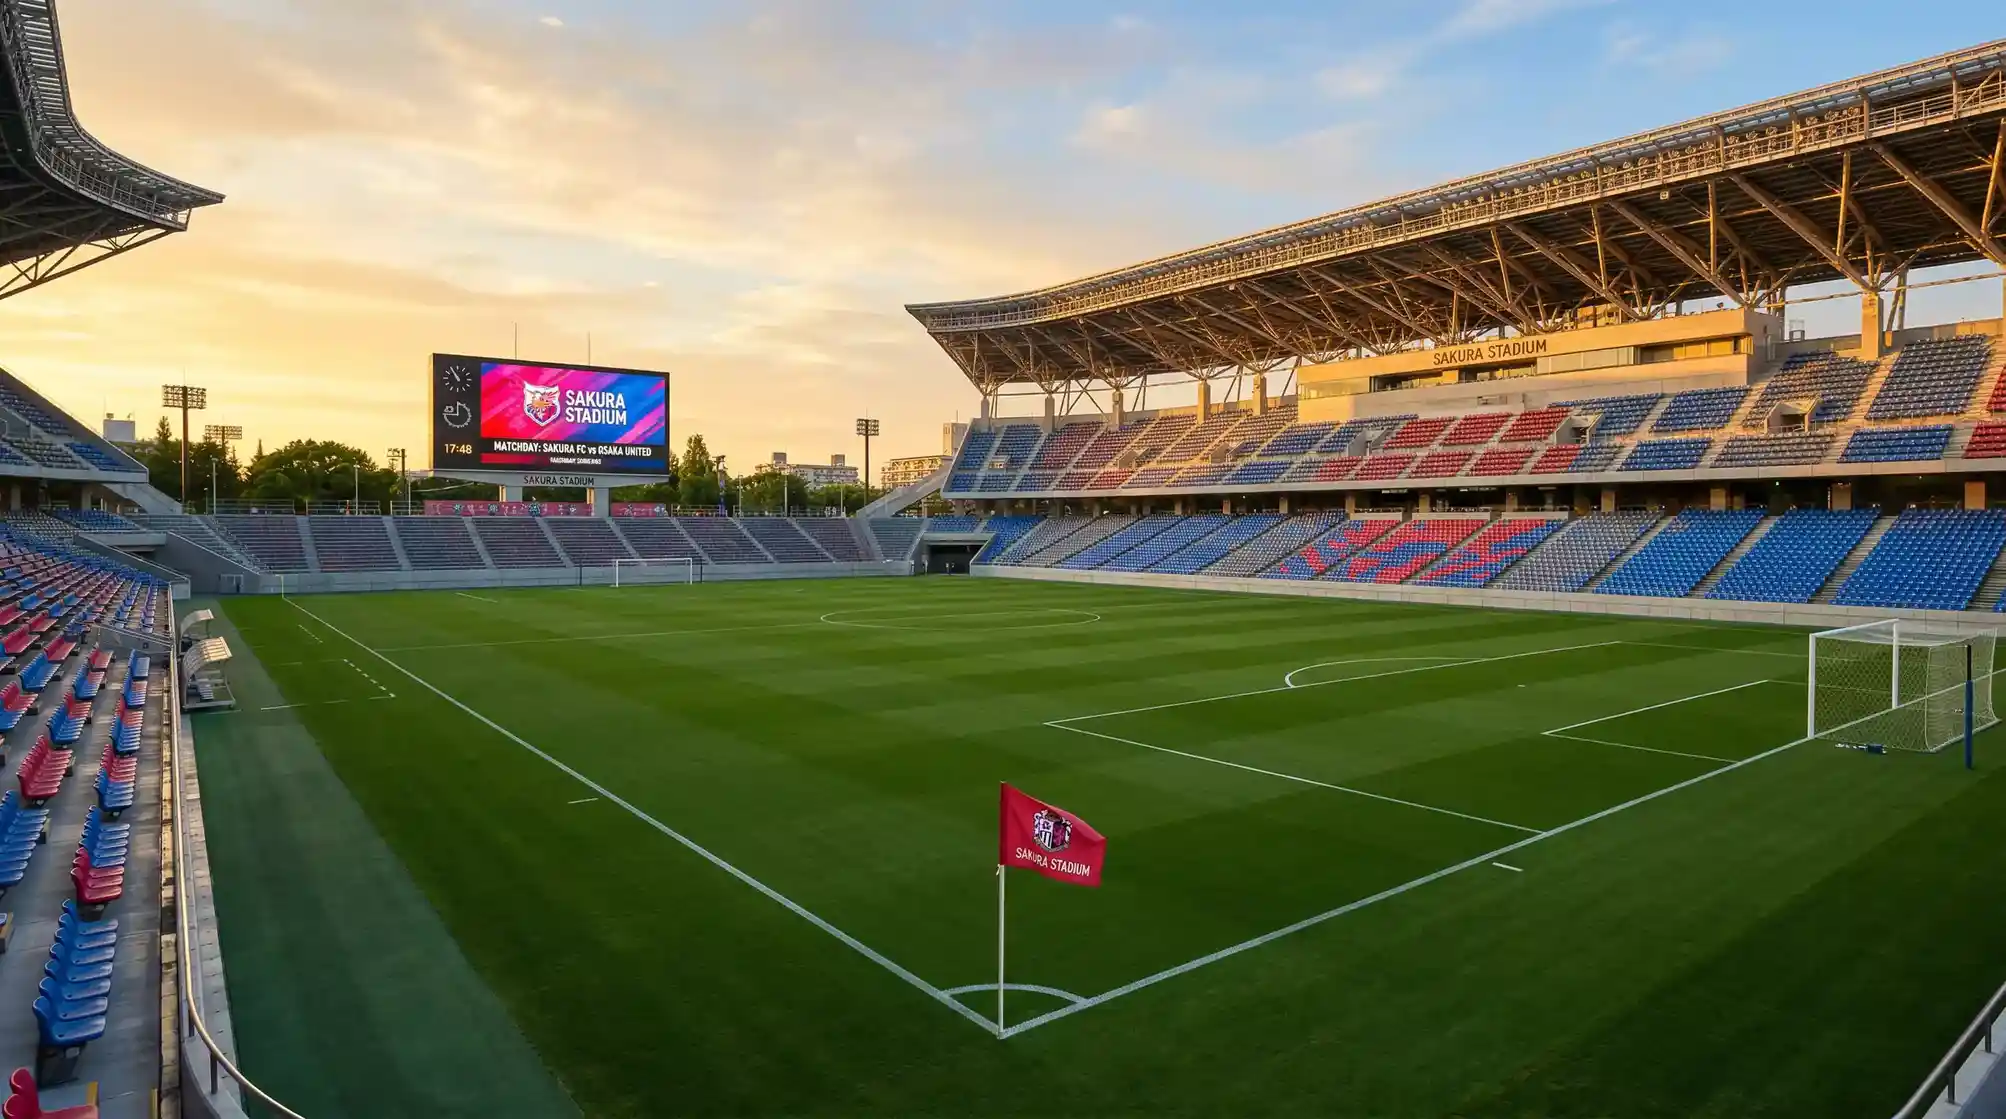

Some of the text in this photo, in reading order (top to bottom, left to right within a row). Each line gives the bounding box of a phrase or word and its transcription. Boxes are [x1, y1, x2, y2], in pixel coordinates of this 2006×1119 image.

[1433, 339, 1547, 365] SAKURA STADIUM
[565, 389, 626, 409] SAKURA
[565, 407, 627, 425] STADIUM
[444, 443, 473, 454] 17:48
[493, 441, 541, 453] MATCHDAY:
[543, 443, 575, 454] SAKURA
[576, 444, 587, 454] FC
[587, 447, 597, 455] vs
[625, 447, 652, 457] UNITED
[523, 475, 595, 486] SAKURA STADIUM
[1015, 847, 1091, 877] SAKURA STADIUM
